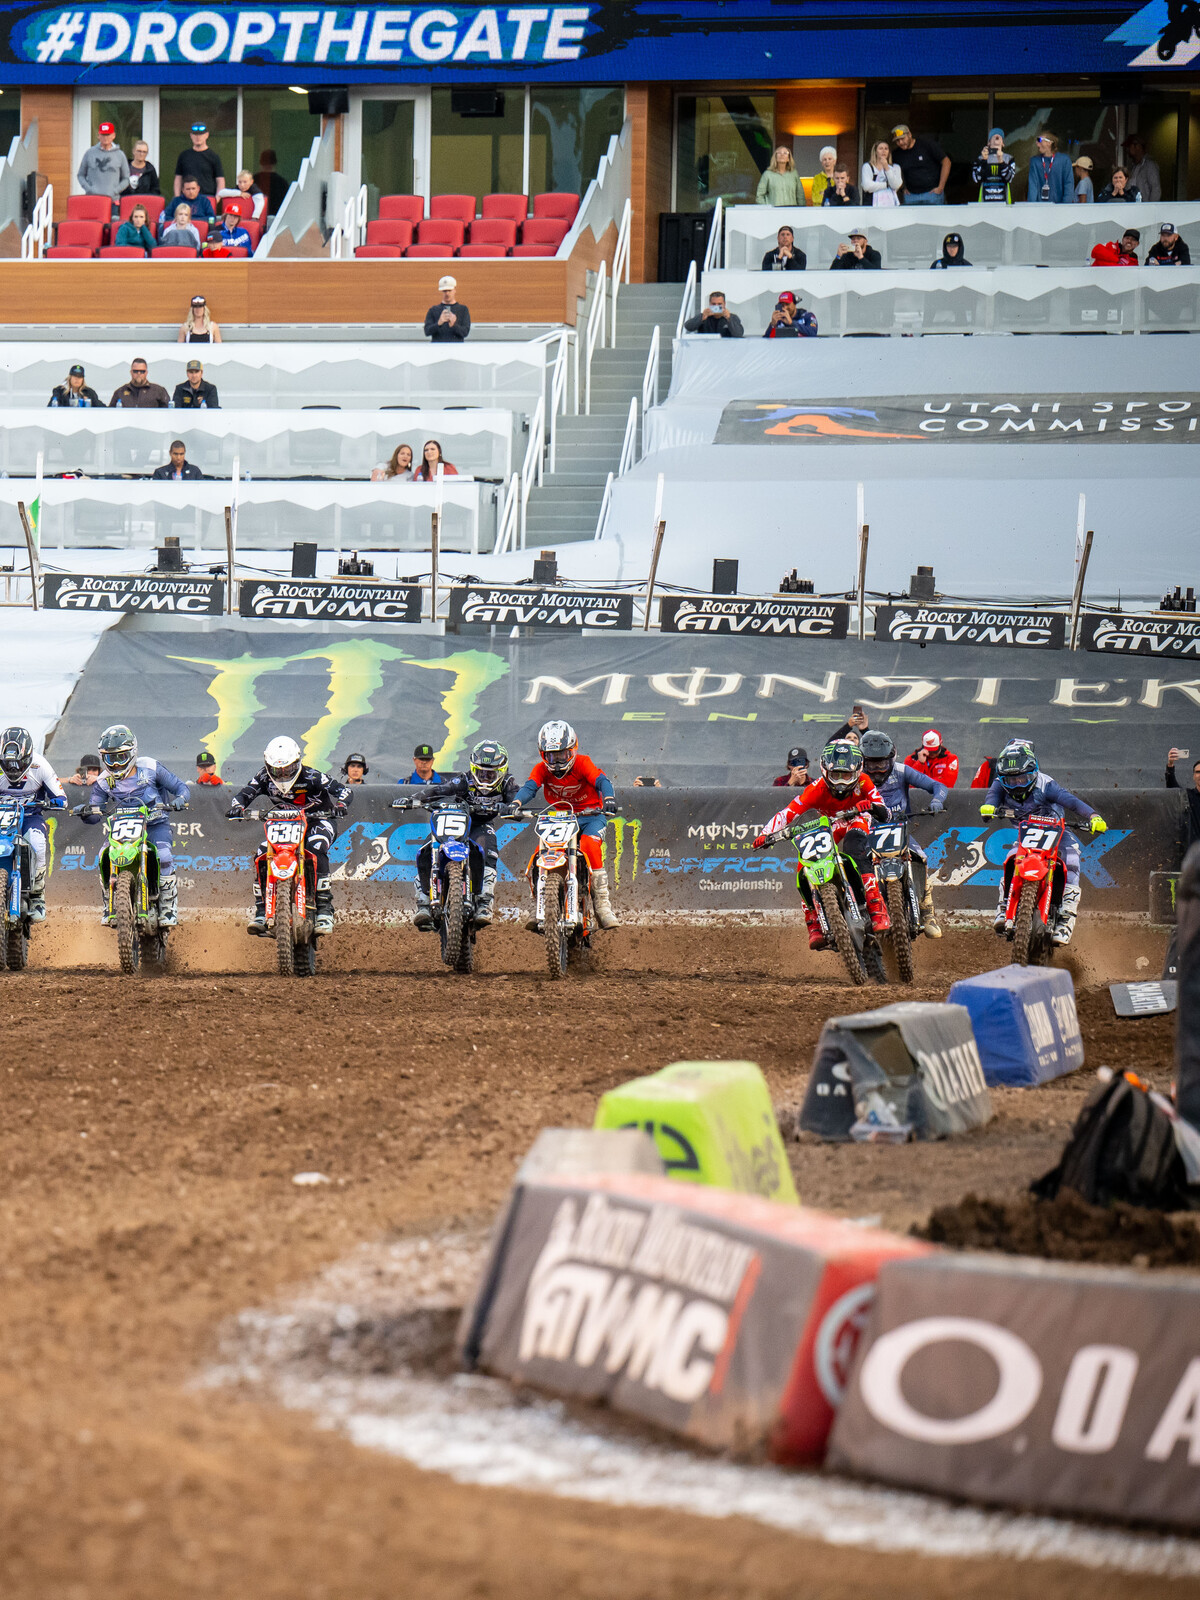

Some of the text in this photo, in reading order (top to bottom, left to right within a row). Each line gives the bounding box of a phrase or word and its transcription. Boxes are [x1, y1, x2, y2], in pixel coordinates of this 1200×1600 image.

[37, 8, 589, 63] #DROPTHEGATE
[81, 578, 212, 594] ROCKY MOUNTAIN
[276, 584, 410, 601] ROCKY MOUNTAIN
[486, 591, 621, 609] ROCKY MOUNTAIN
[700, 600, 835, 618] ROCKY MOUNTAIN
[914, 608, 1054, 628] ROCKY MOUNTAIN
[1119, 619, 1173, 634] ROCKY
[112, 819, 143, 840] 55
[267, 824, 304, 844] 636
[436, 815, 467, 836] 15
[538, 822, 576, 842] 731
[800, 831, 832, 859] 23
[874, 827, 902, 849] 71
[1022, 828, 1059, 850] 21
[65, 846, 85, 855] AMA
[699, 879, 783, 892] Championship
